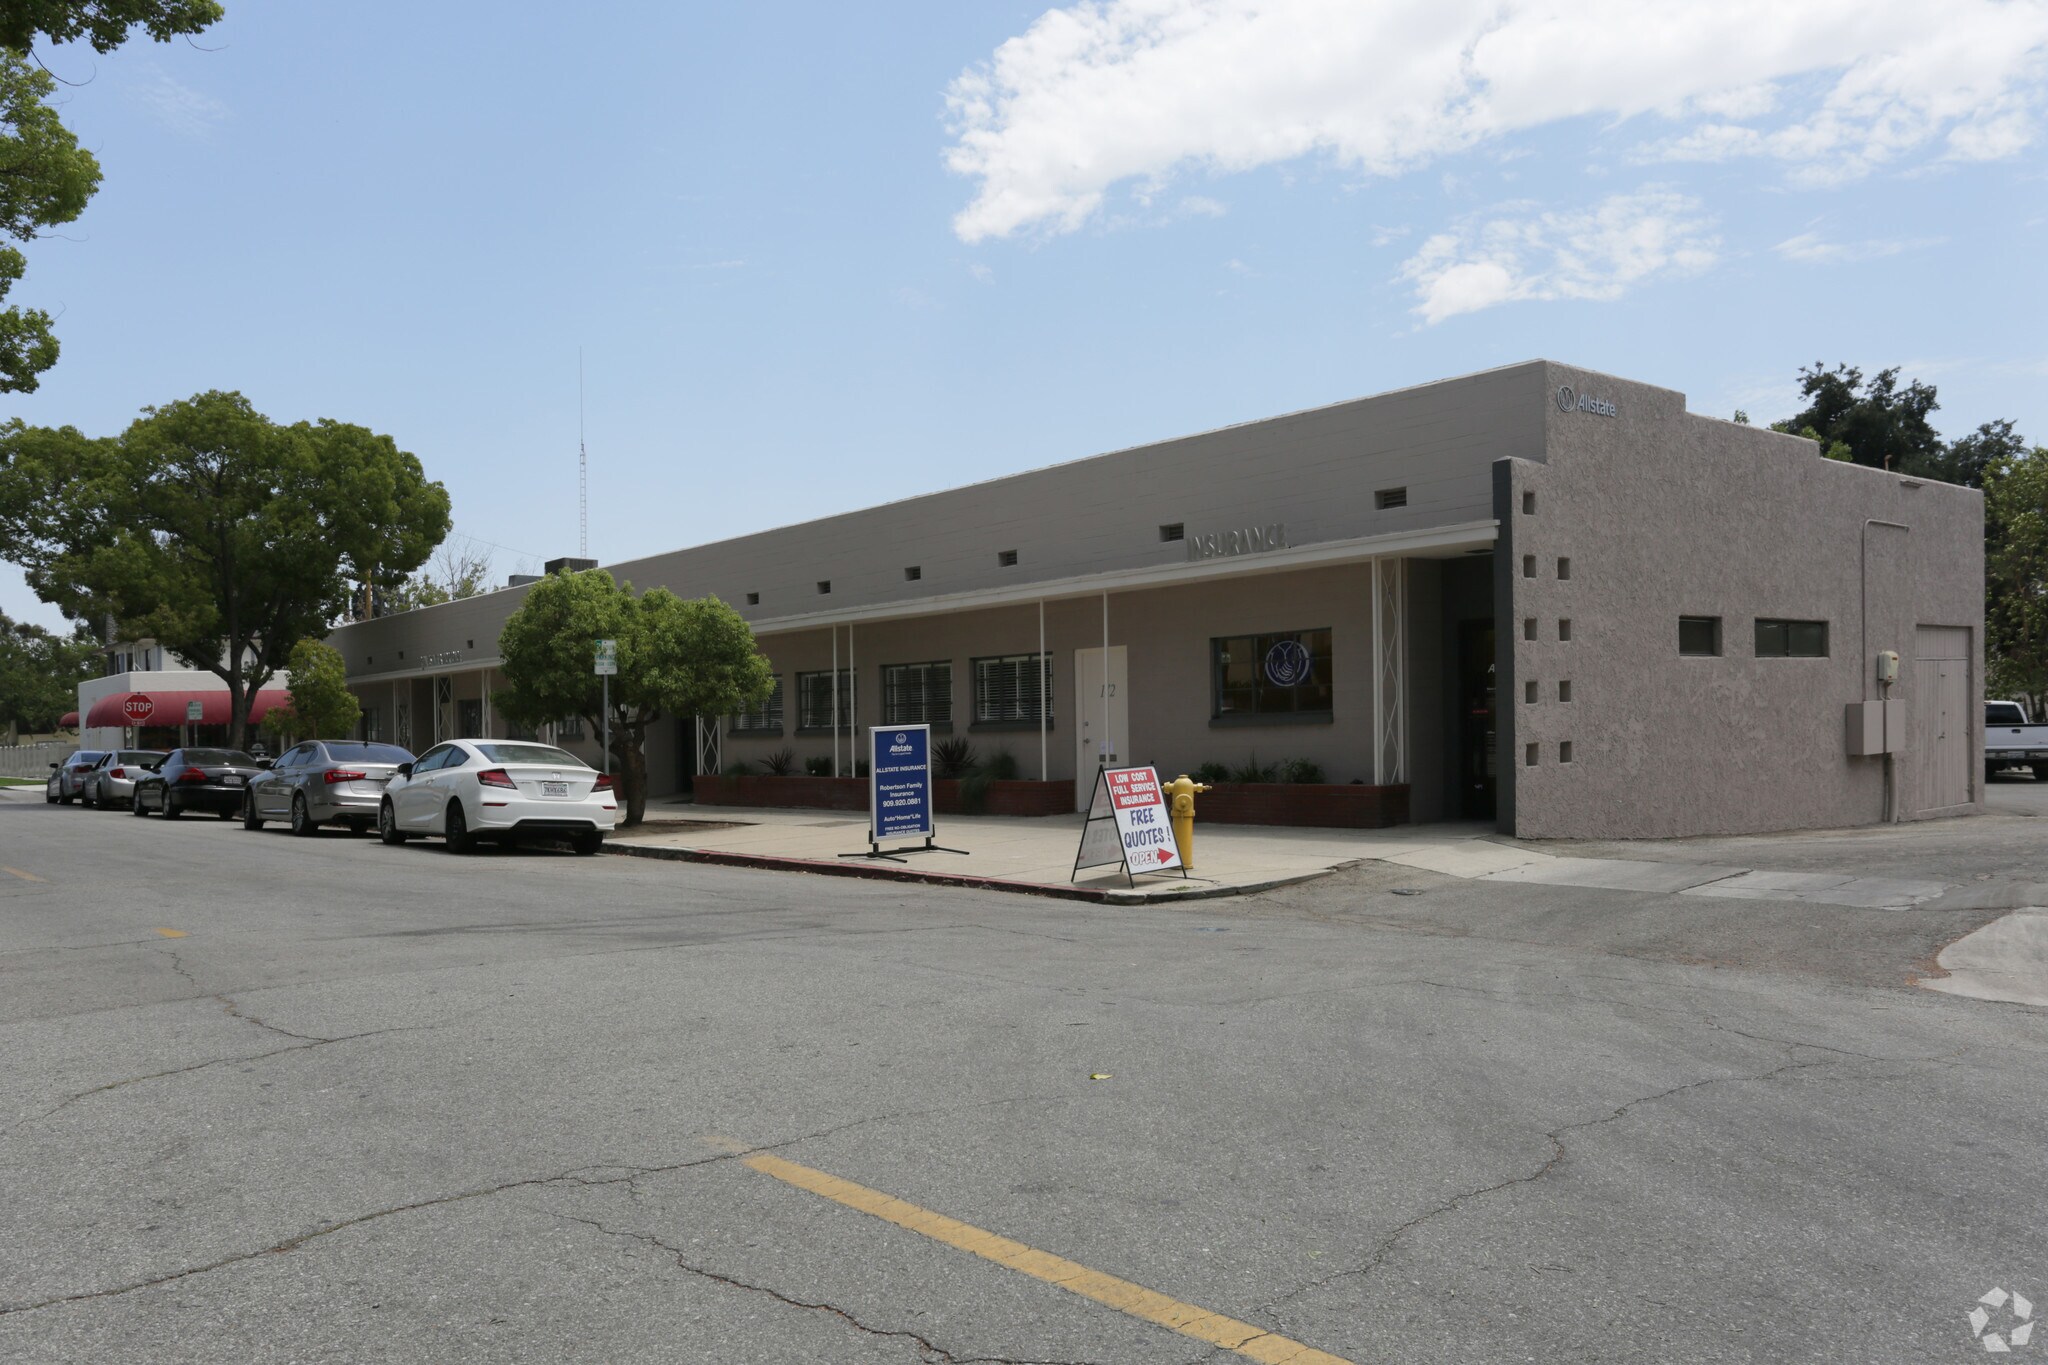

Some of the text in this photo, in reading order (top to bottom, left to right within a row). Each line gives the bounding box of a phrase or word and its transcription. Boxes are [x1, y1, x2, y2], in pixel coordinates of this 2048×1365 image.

[1577, 393, 1617, 418] Allstate
[1187, 523, 1288, 562] INSURANCE
[1100, 683, 1116, 698] 12
[125, 701, 152, 712] STOP
[1115, 772, 1147, 783] LOW COST
[1113, 782, 1156, 795] FULL SERVICE
[1120, 794, 1155, 805] INSURANCE
[1130, 807, 1155, 826] FREE
[1124, 827, 1165, 848] QUOTES
[1130, 851, 1159, 866] OPEN
